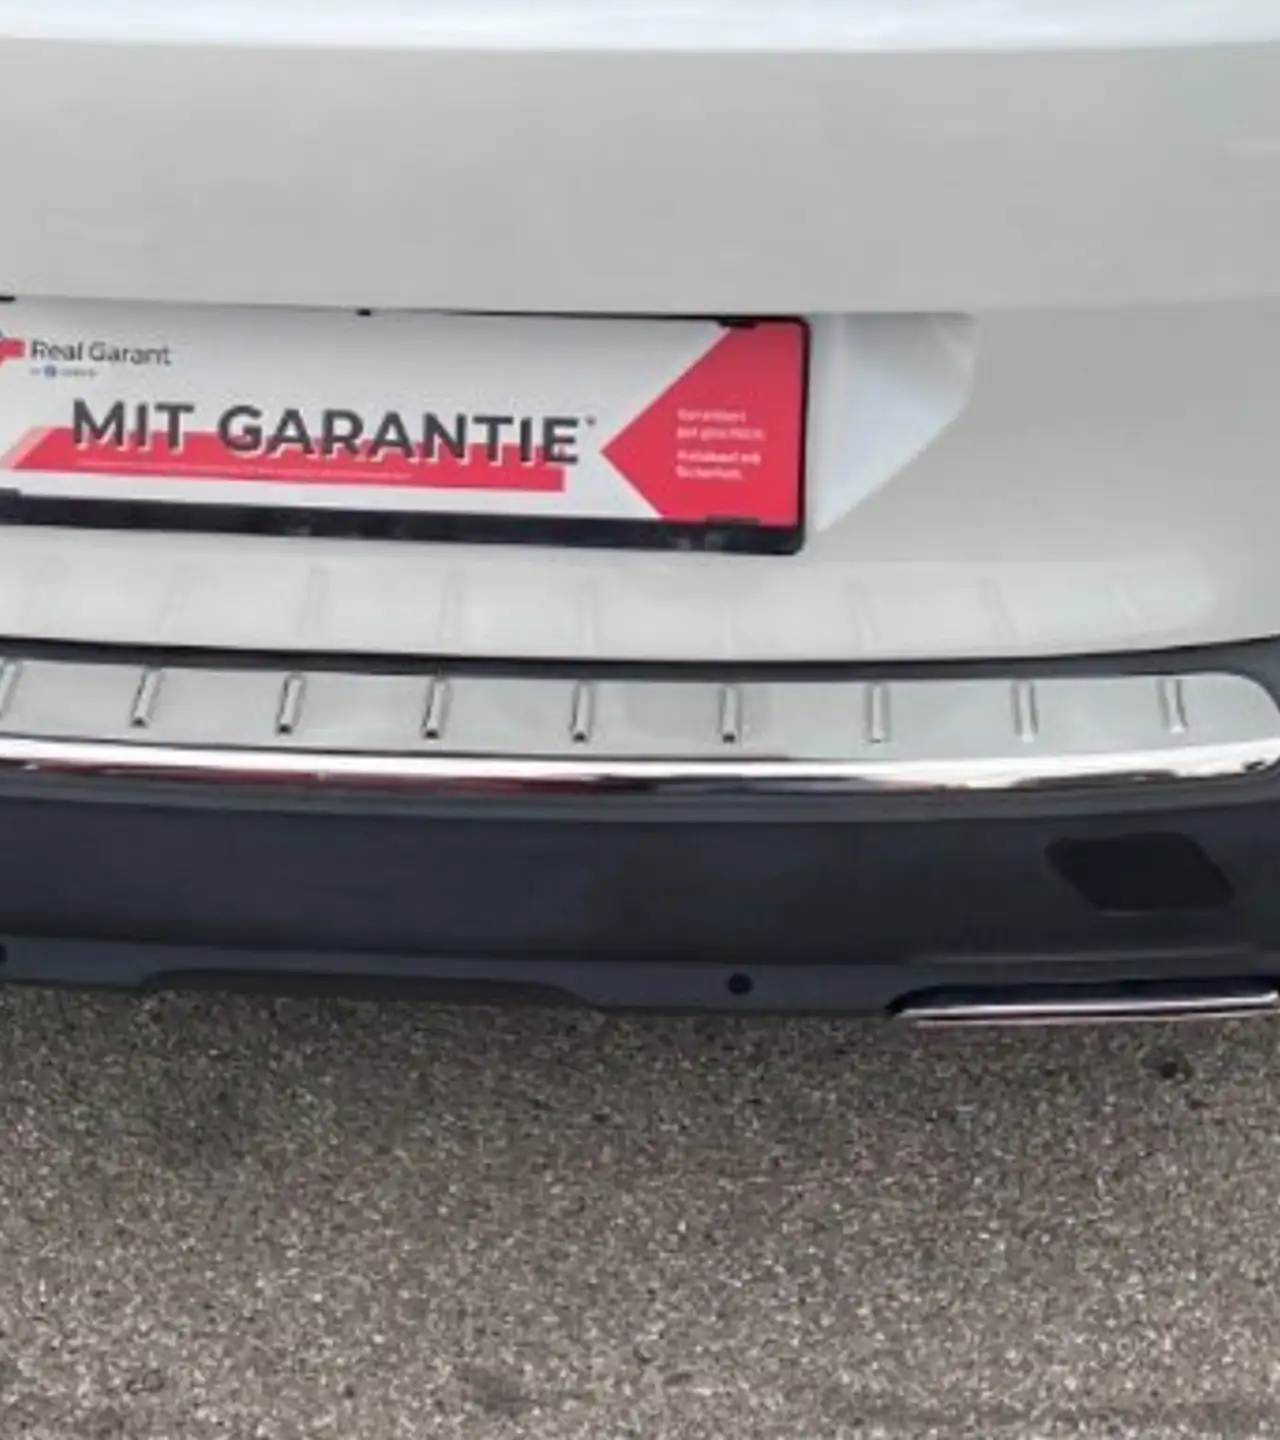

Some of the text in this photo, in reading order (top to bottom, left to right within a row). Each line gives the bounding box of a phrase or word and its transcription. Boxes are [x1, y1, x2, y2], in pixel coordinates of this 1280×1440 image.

[31, 340, 173, 366] Real Garant
[72, 399, 194, 450] MIT
